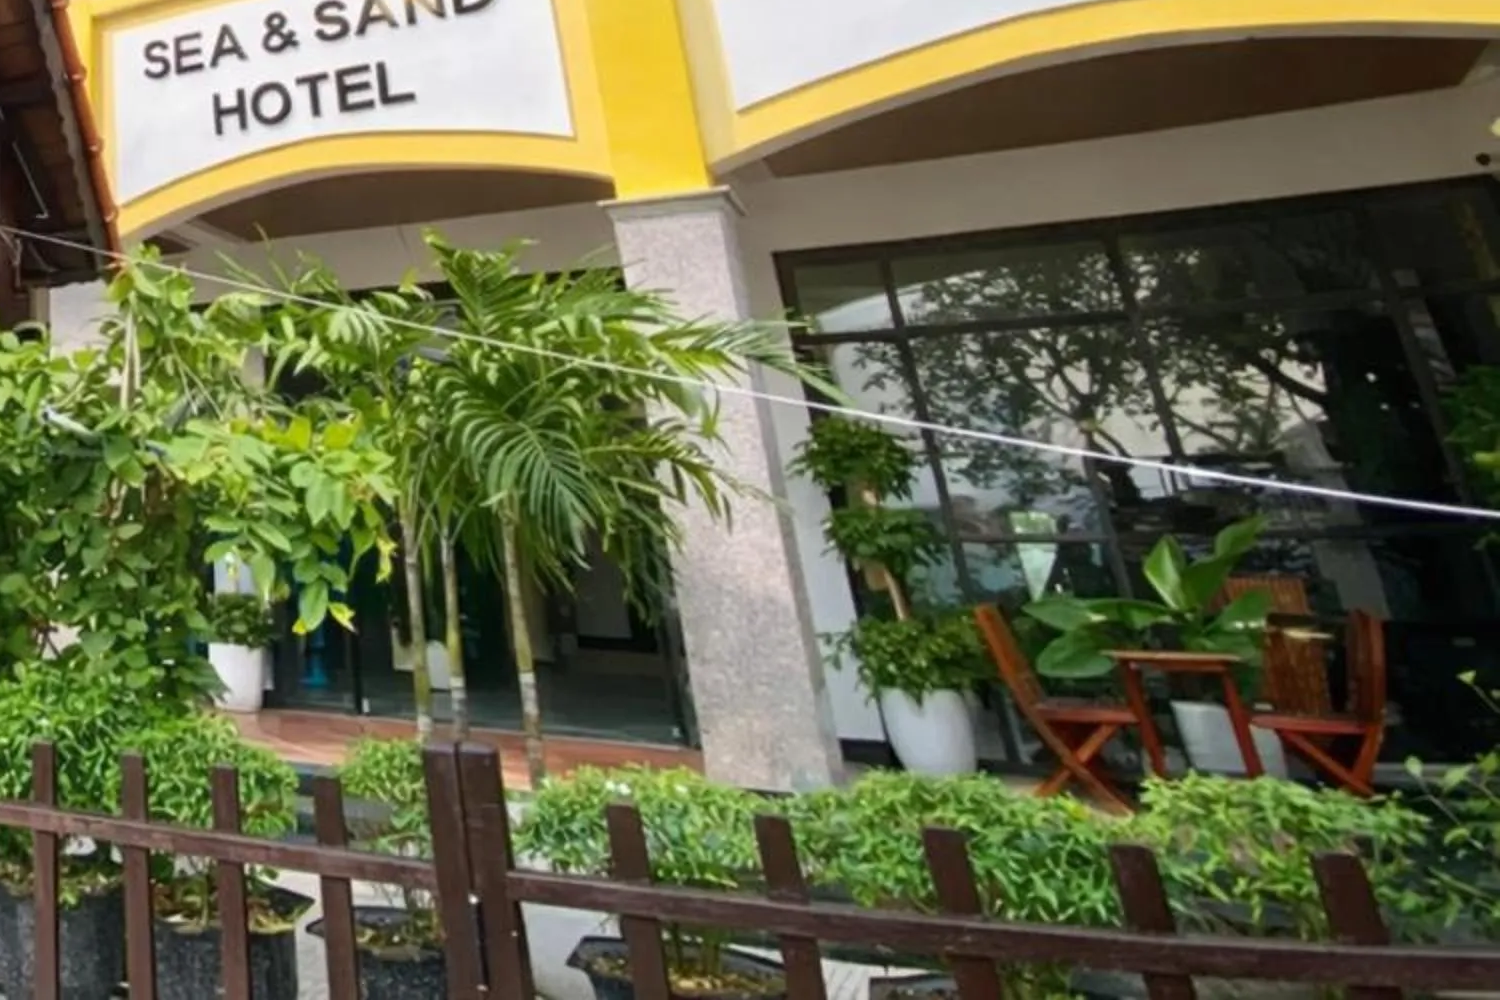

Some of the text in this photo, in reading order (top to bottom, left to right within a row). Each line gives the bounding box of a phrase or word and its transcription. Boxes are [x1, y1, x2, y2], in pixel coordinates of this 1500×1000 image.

[143, 23, 248, 80] SEA
[261, 11, 300, 55] &
[212, 61, 417, 136] HOTEL
